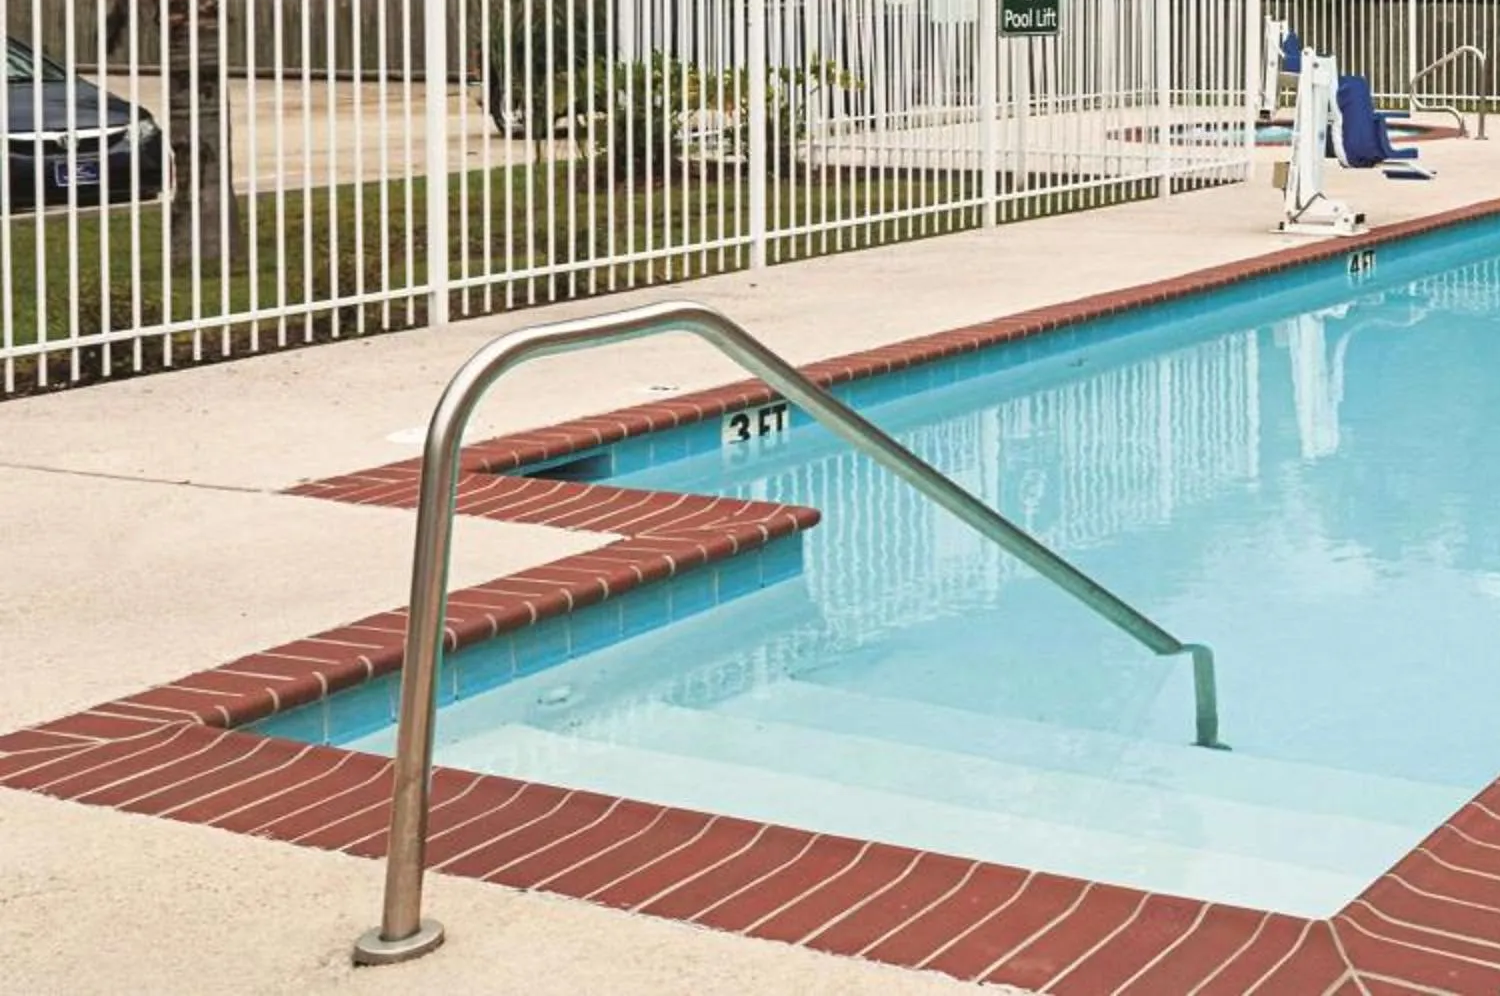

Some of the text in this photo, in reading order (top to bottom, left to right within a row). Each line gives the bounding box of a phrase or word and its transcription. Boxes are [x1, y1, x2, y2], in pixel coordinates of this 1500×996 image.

[1004, 7, 1056, 28] Pool Lift
[1350, 253, 1360, 274] 4
[729, 403, 787, 444] 3 FT
